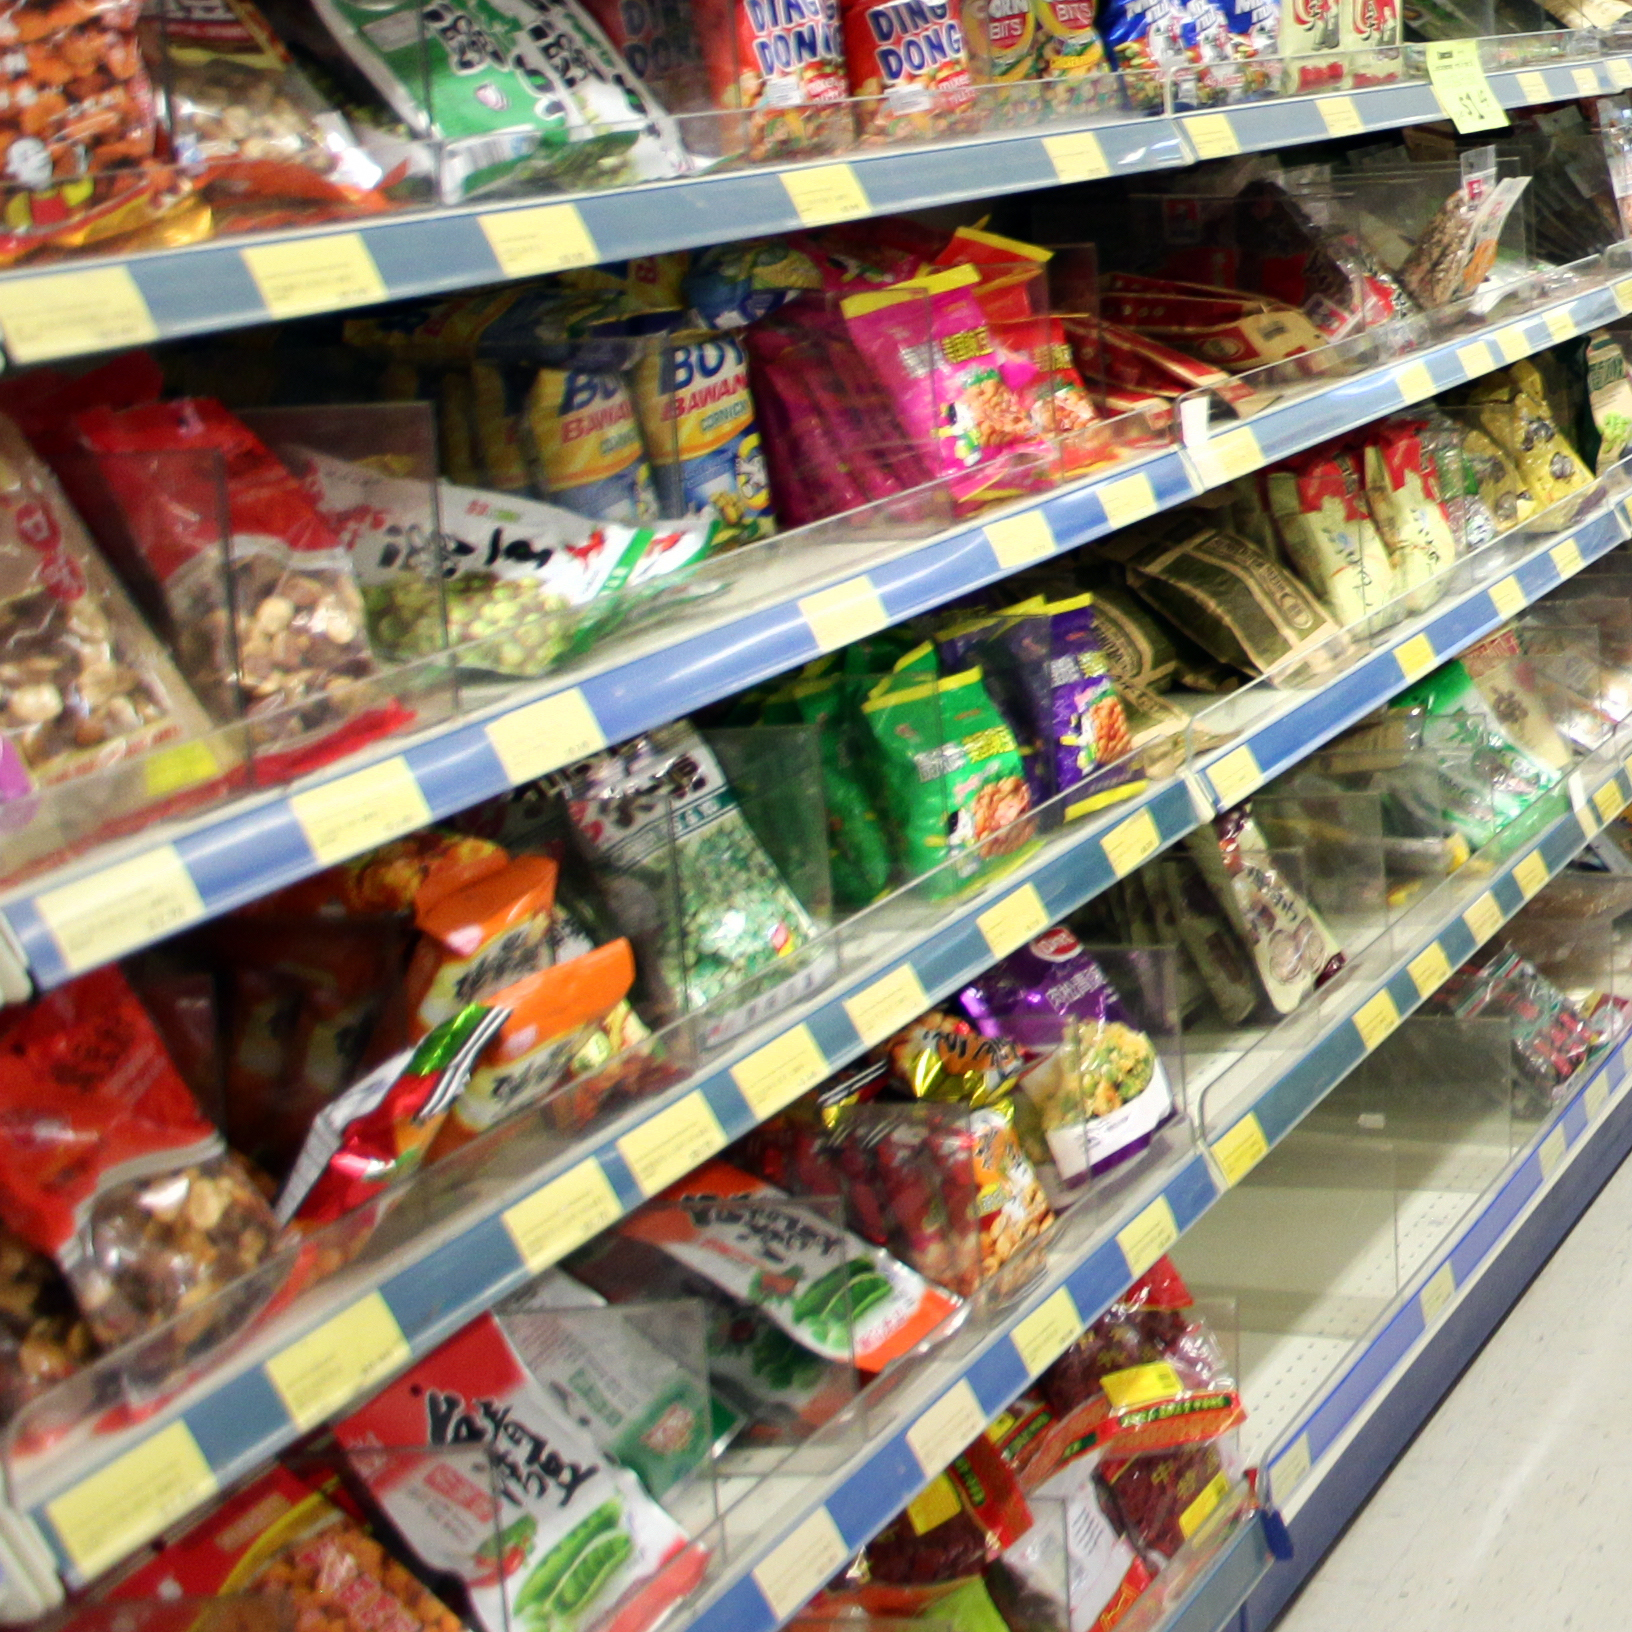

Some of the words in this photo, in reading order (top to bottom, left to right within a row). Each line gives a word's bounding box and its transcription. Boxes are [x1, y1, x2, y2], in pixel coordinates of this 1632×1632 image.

[988, 18, 1023, 41] BITS
[1055, 0, 1093, 23] BITS
[874, 21, 963, 84] DONG
[660, 373, 749, 422] BAWAN
